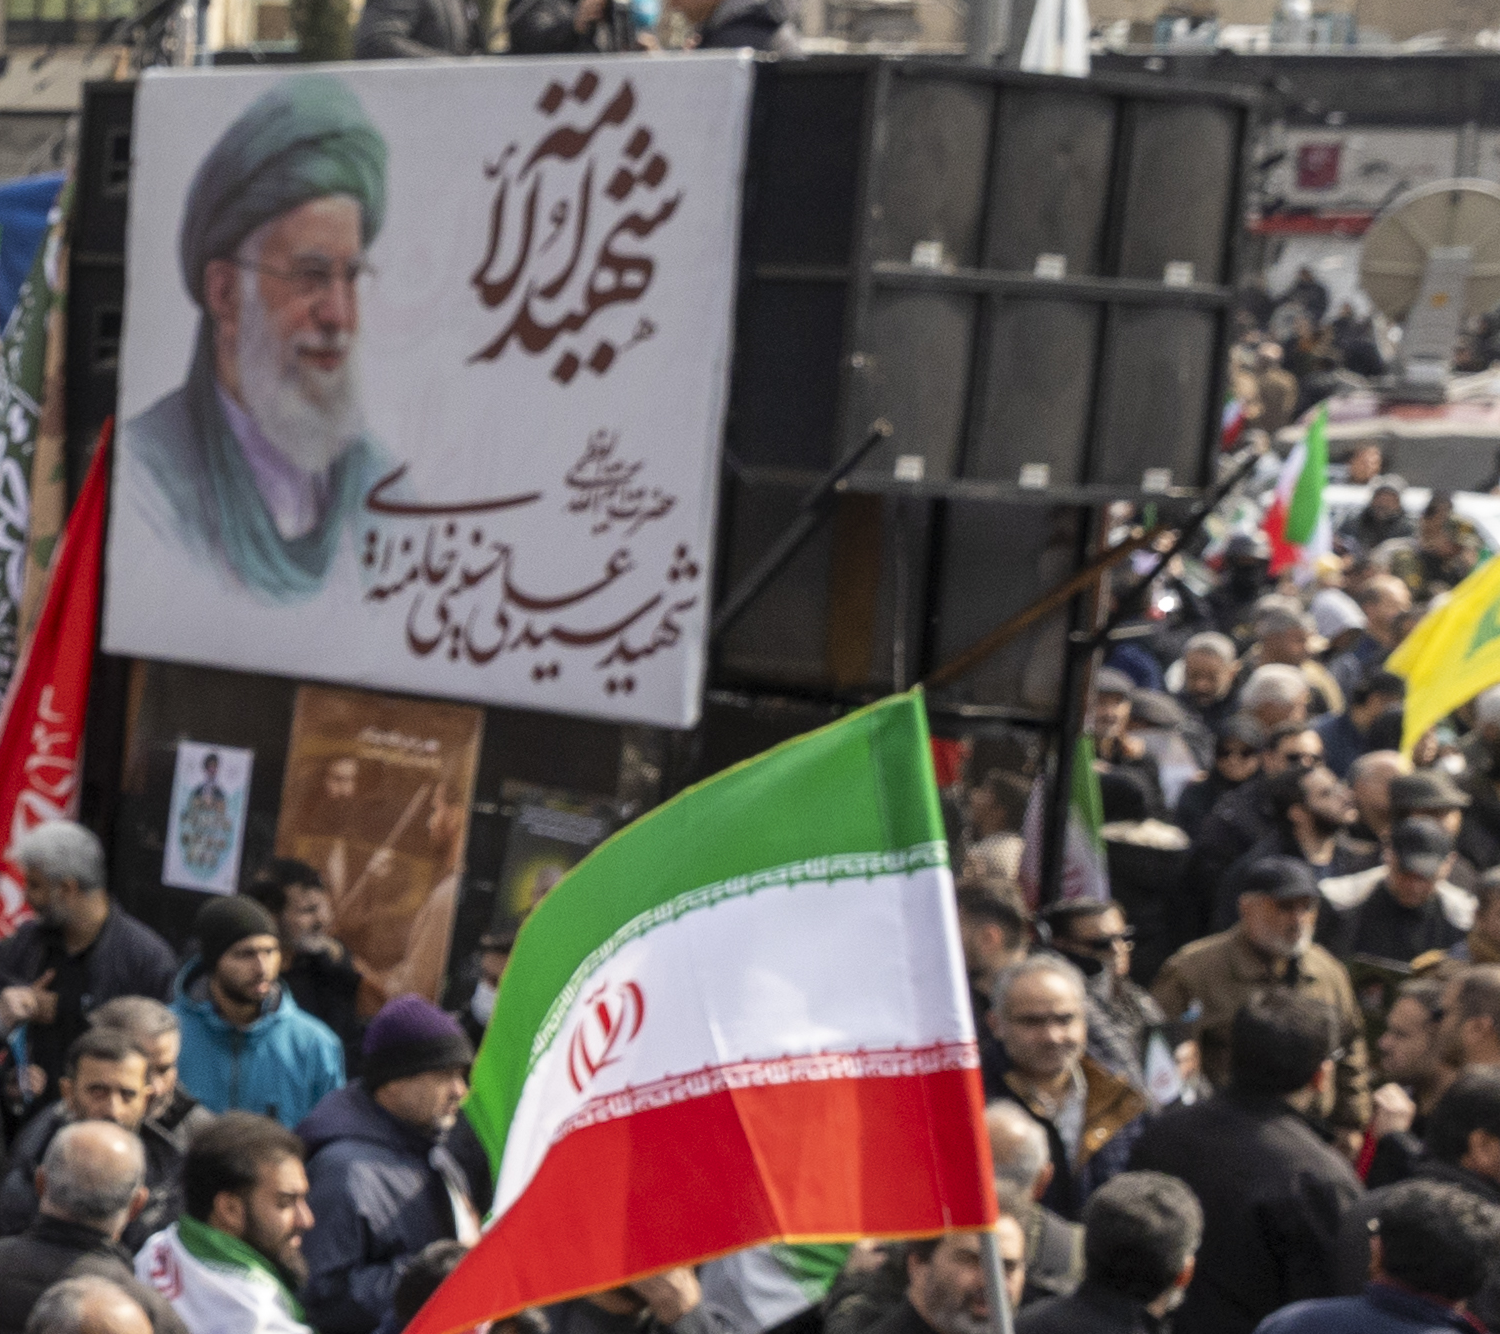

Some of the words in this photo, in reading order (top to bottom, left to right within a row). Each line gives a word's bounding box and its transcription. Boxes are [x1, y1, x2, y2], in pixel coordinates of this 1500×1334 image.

[466, 124, 684, 386] شهید
[407, 528, 511, 660] حسینی
[464, 548, 635, 666] علی
[511, 593, 663, 683] سید
[596, 542, 699, 694] شهید
